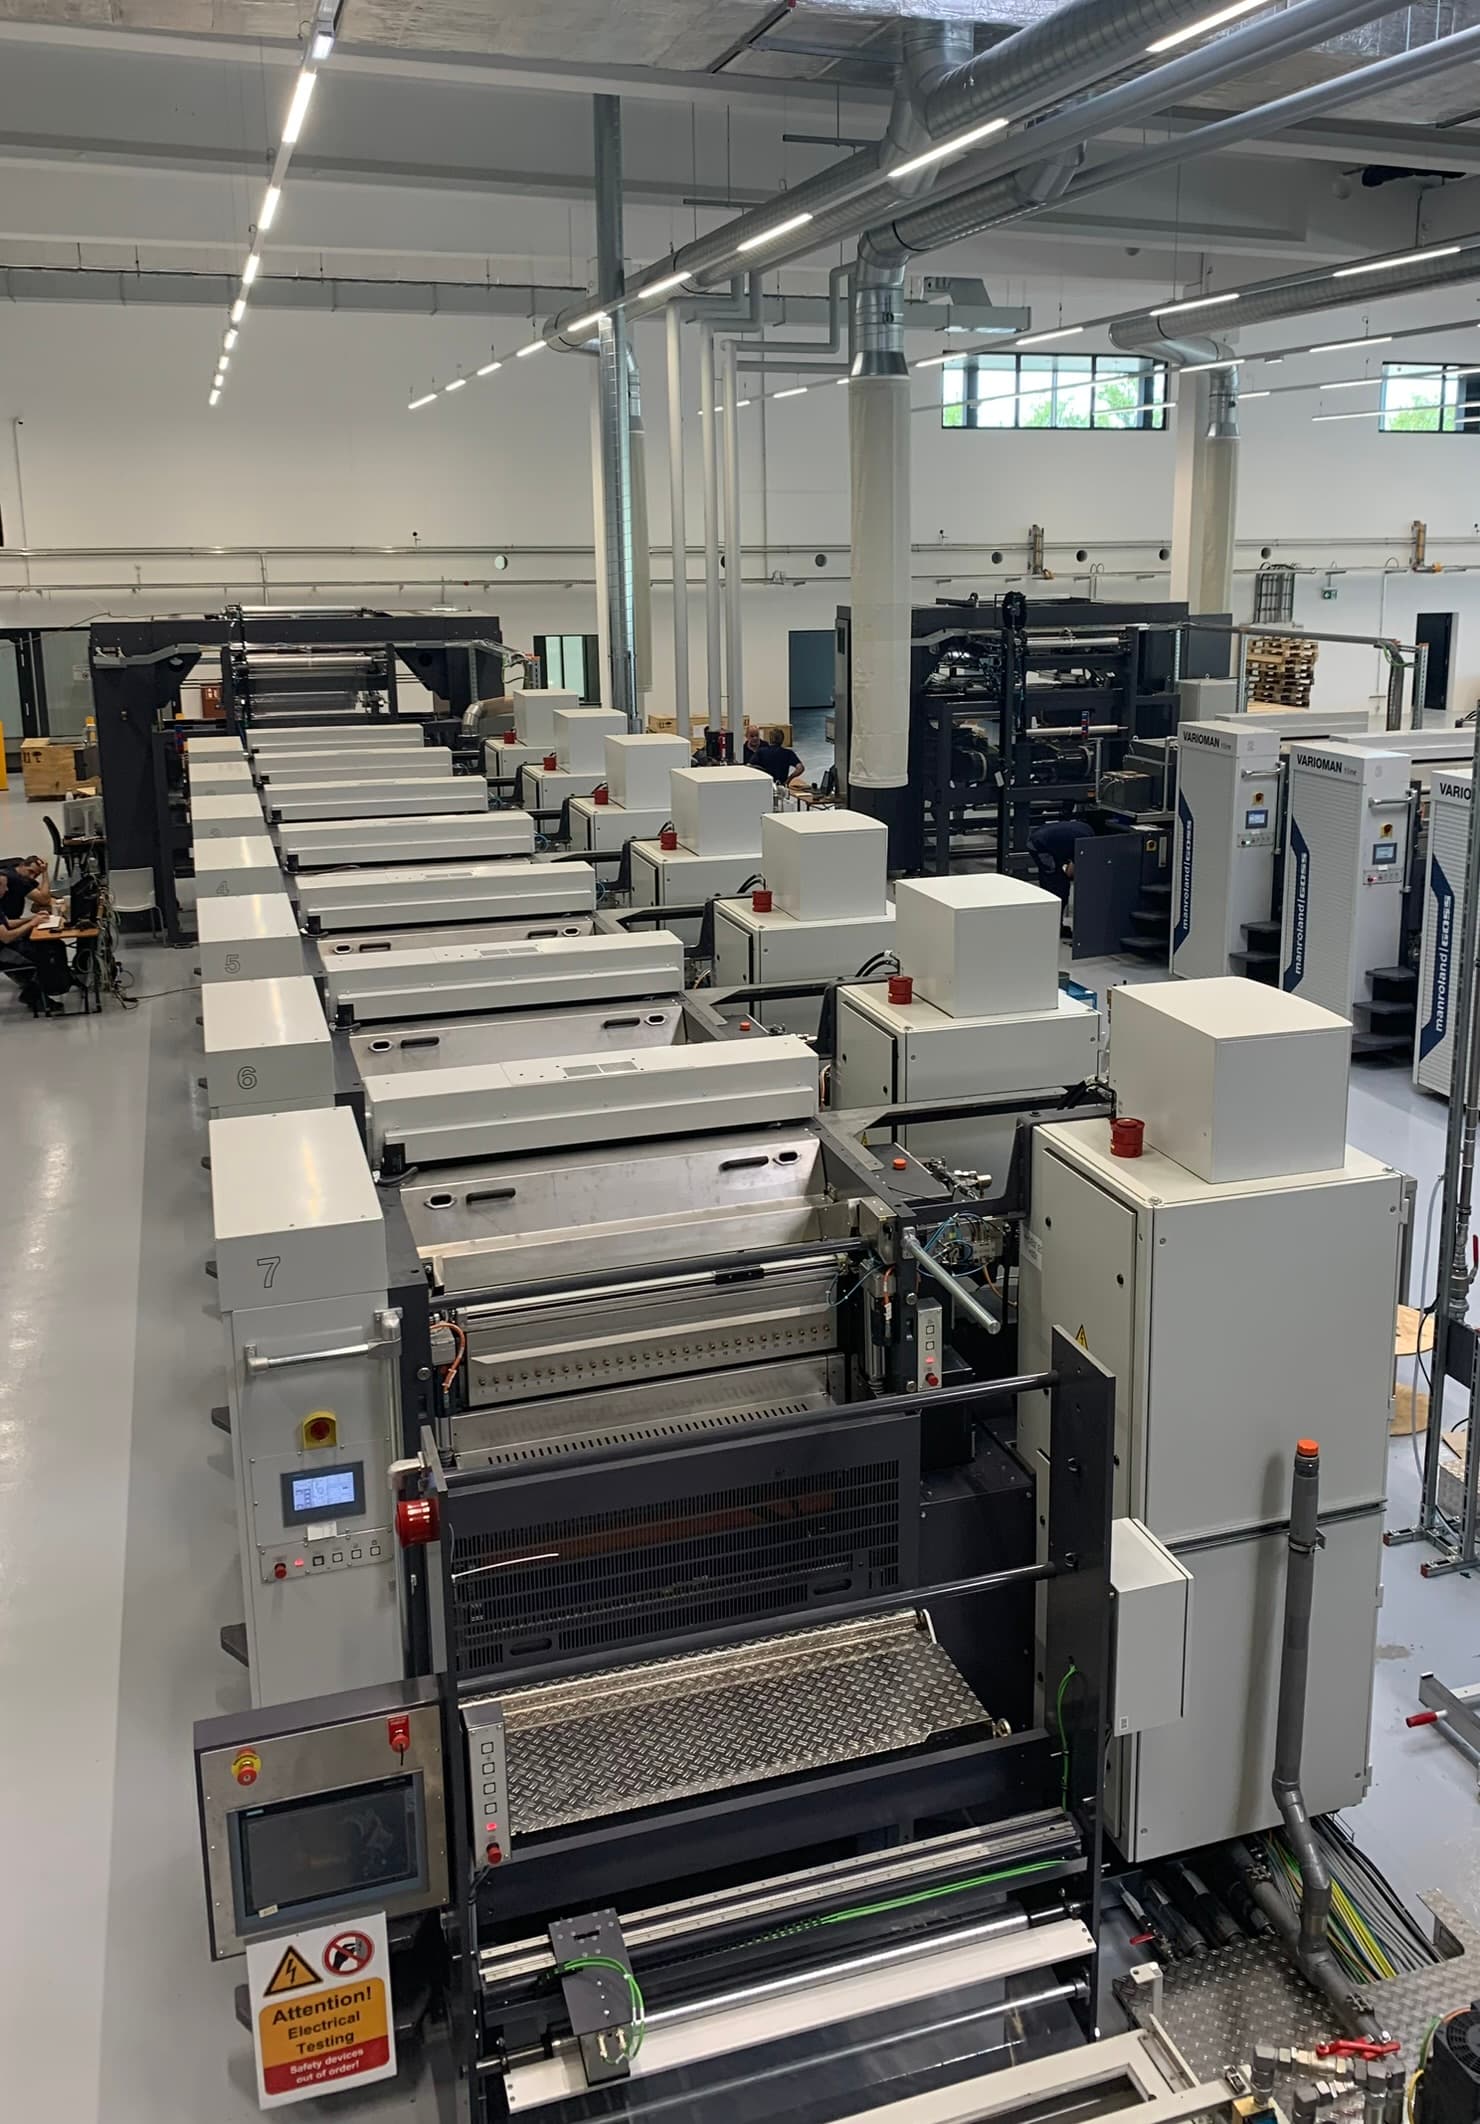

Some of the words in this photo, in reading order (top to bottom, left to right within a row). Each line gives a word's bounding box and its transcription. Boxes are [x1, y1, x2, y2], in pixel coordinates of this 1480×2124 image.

[1183, 731, 1220, 748] VARIOMAN
[1297, 753, 1343, 773] VARIOMAN
[1440, 782, 1472, 800] VARIO
[216, 880, 230, 896] 4
[224, 954, 241, 974] 5
[237, 1065, 258, 1090] 6
[256, 1256, 281, 1288] 7
[272, 1986, 372, 2026] Attention!
[288, 2011, 361, 2040] Electrical
[296, 2032, 355, 2055] Testing
[290, 2061, 322, 2075] Safety
[325, 2048, 364, 2065] devices
[296, 2073, 313, 2084] out
[316, 2070, 327, 2079] of
[329, 2060, 360, 2075] order!
